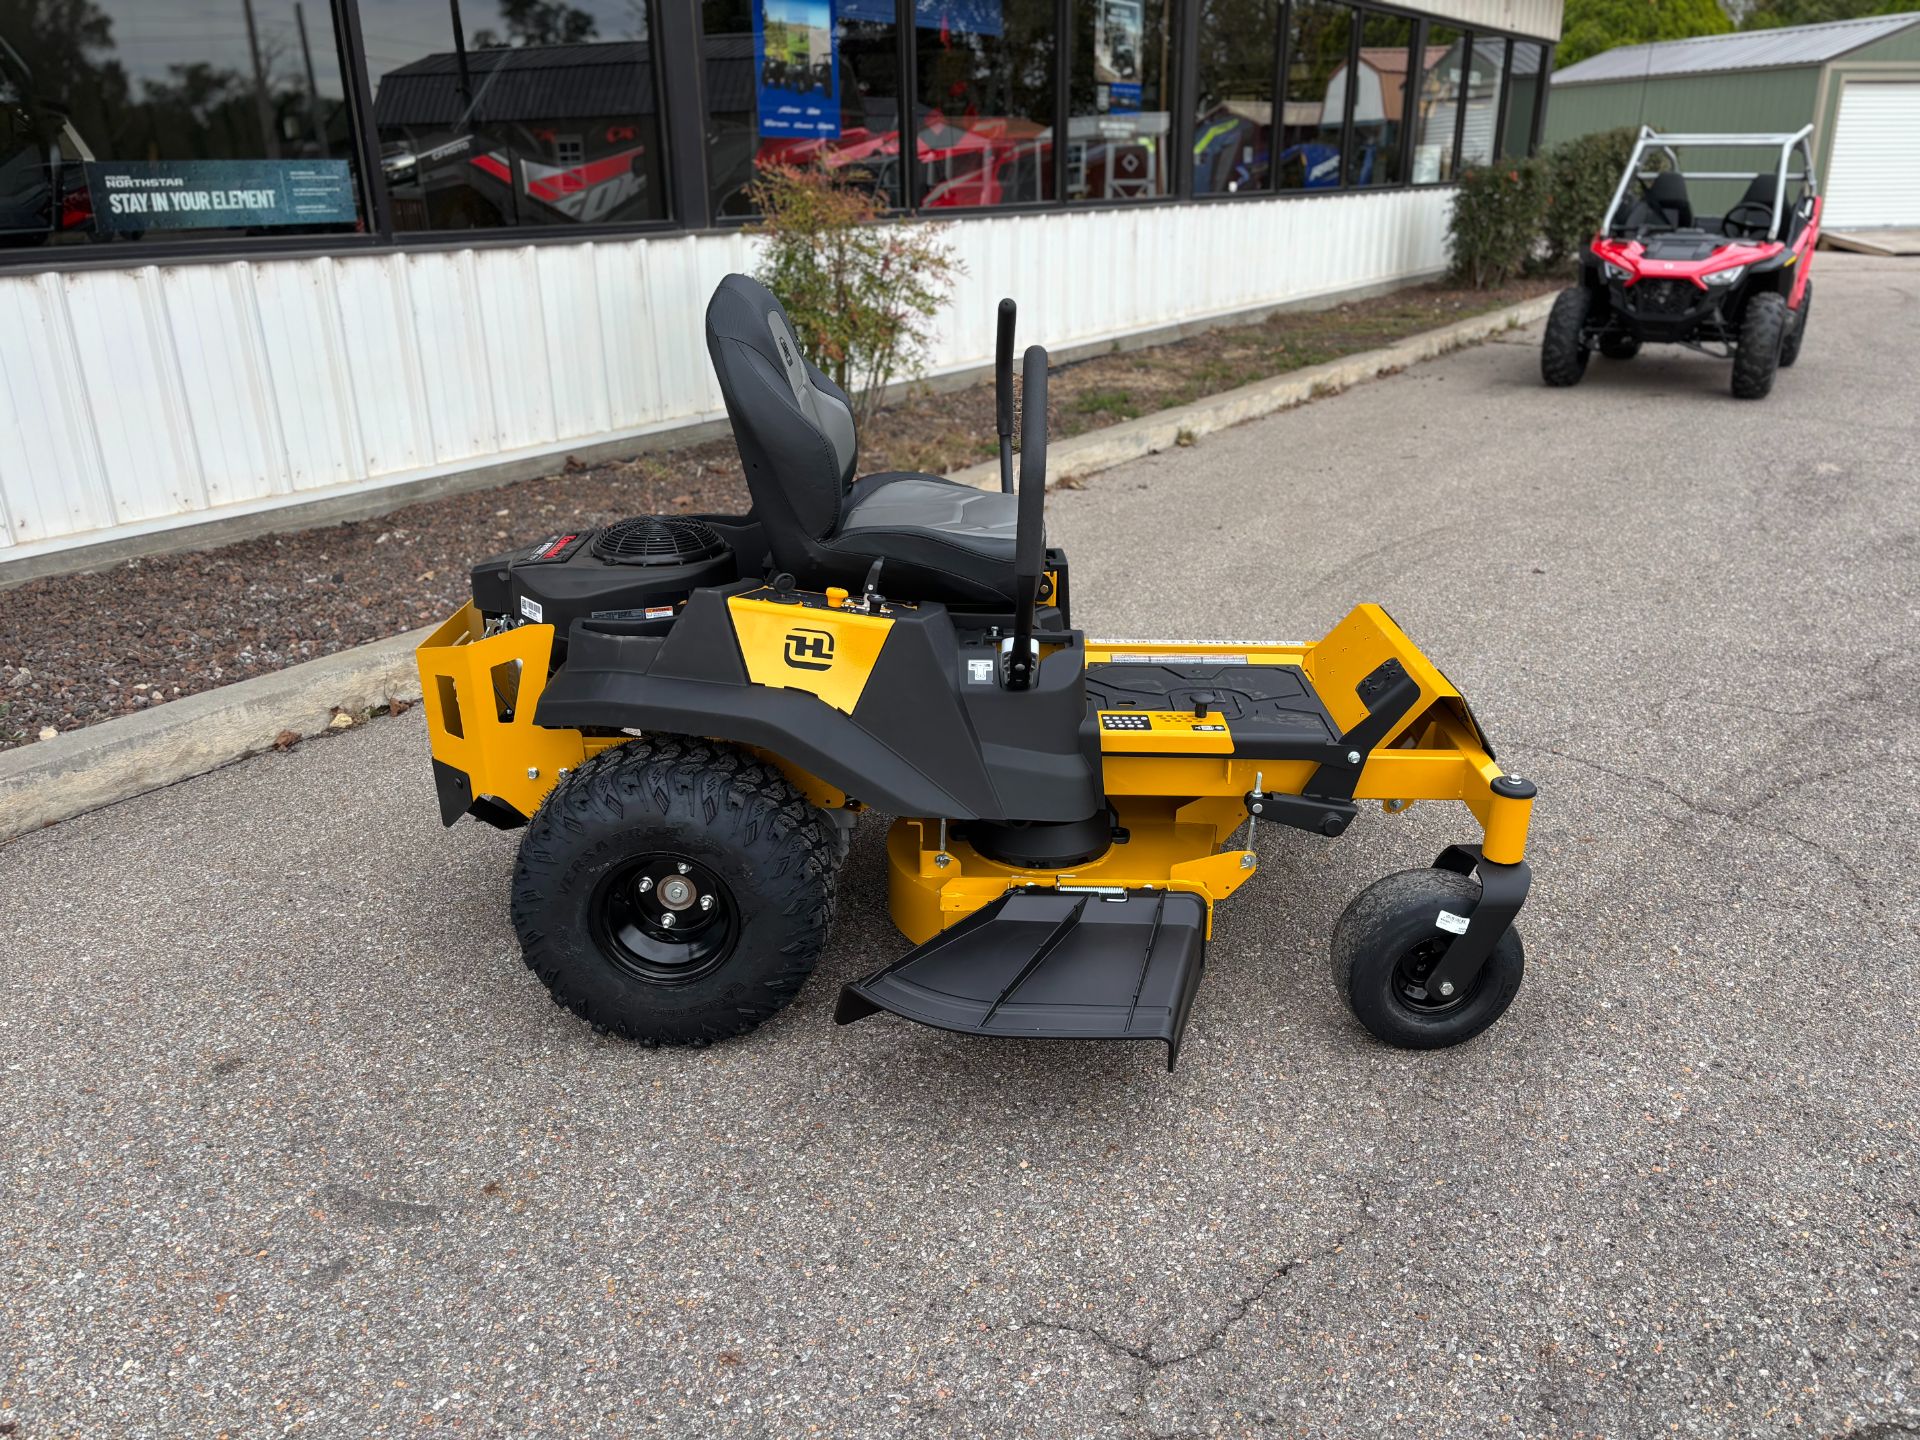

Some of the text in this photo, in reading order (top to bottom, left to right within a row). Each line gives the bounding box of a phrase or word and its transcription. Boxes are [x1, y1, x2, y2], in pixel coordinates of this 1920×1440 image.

[105, 178, 184, 188] NORTHSTAR
[109, 193, 148, 214] STAY
[150, 192, 170, 212] IN
[169, 190, 212, 212] YOUR
[211, 189, 276, 210] ELEMENT
